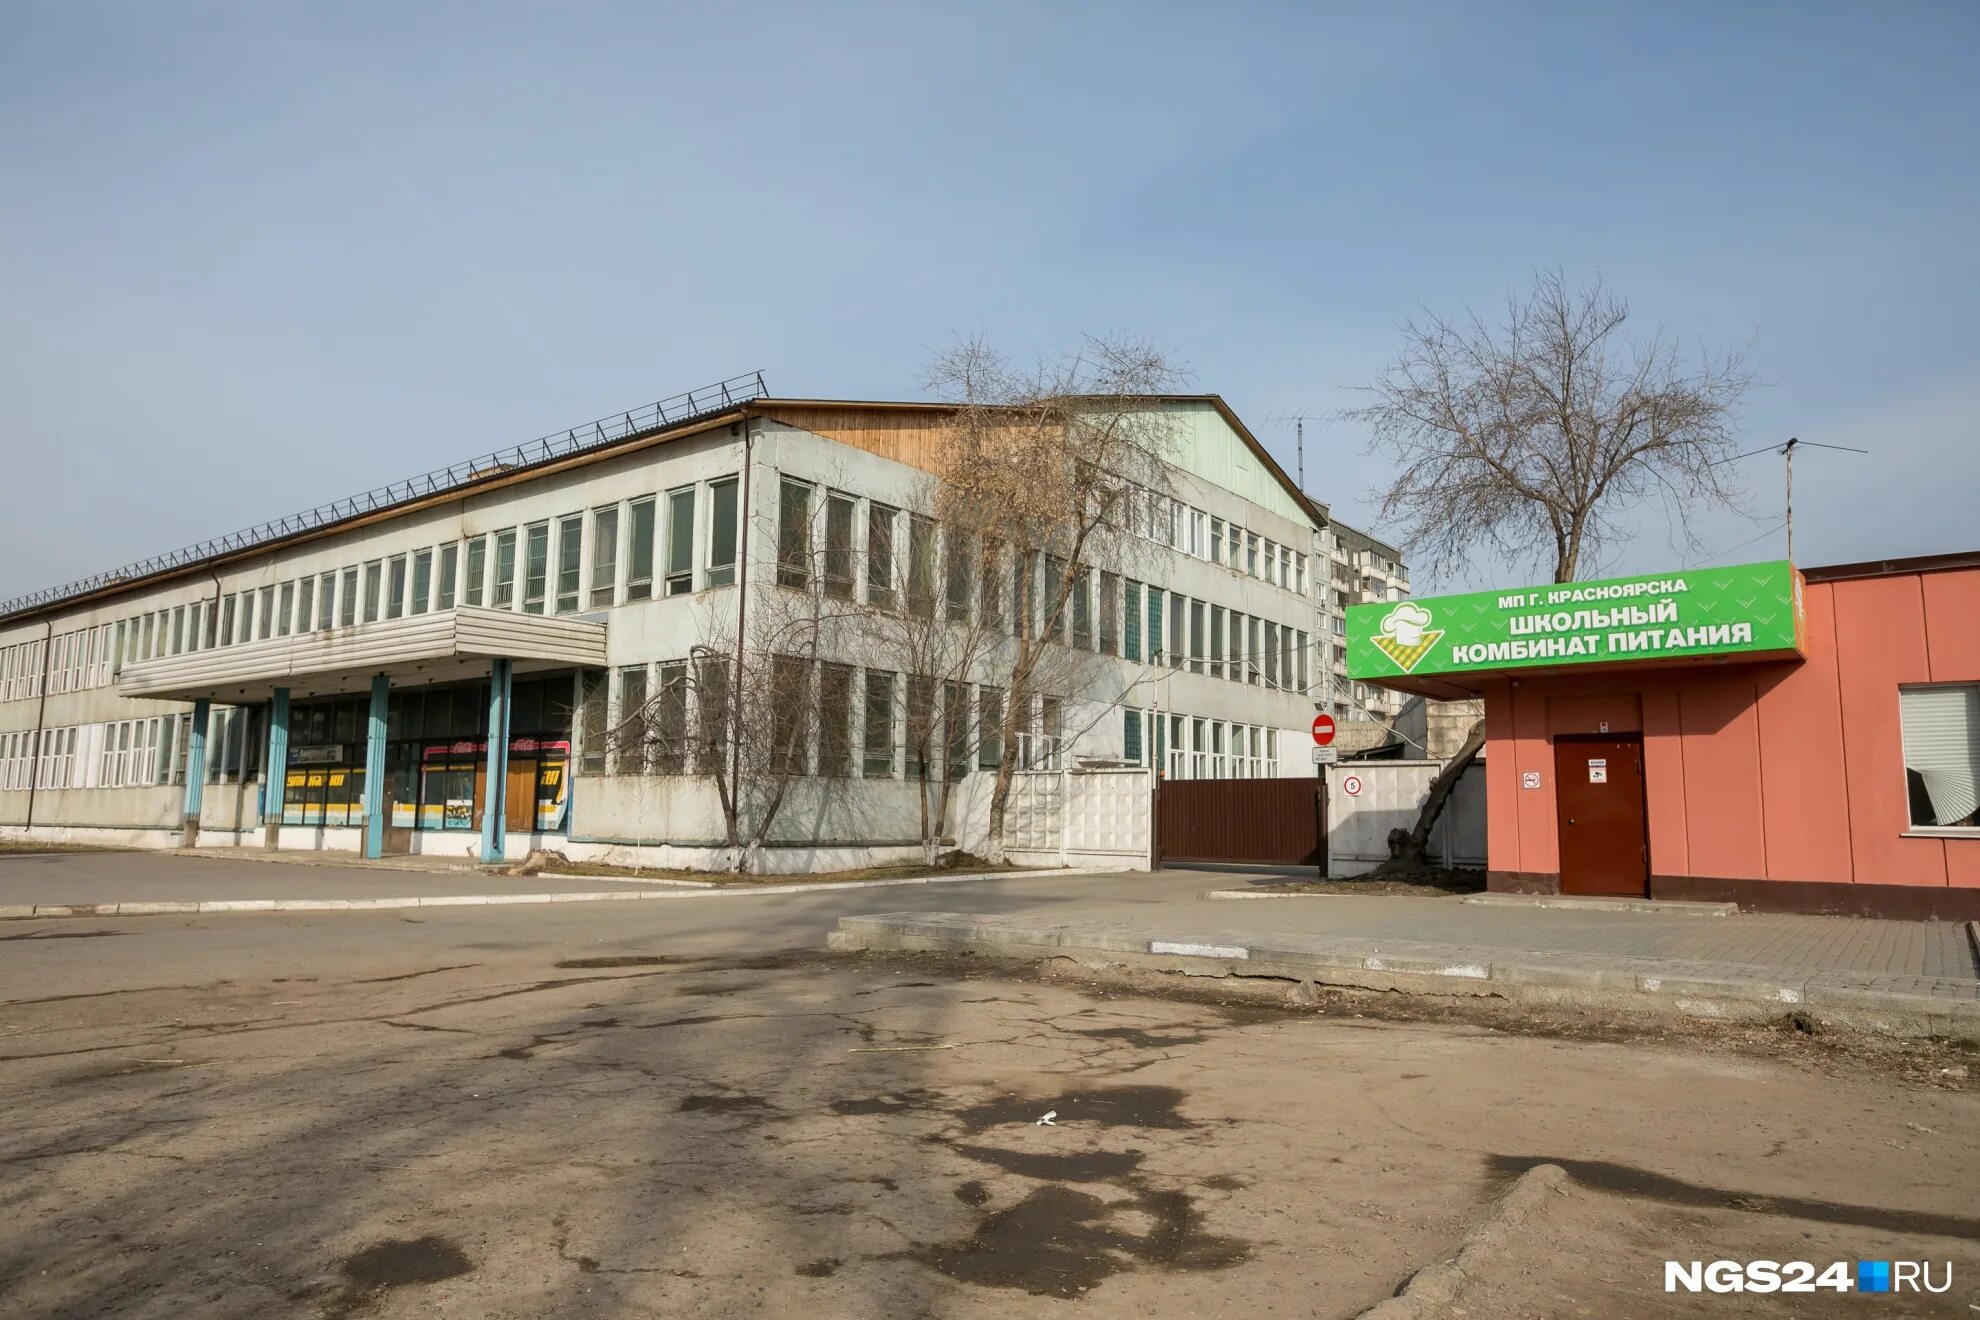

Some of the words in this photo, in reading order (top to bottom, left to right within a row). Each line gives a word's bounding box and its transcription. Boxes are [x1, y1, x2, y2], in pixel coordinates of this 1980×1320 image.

[1498, 595, 1525, 609] МП
[1529, 592, 1544, 607] Г.
[1548, 578, 1688, 605] КРАСНОЯРСКА
[1509, 598, 1678, 636] ШКОЛЬНЫЙ
[1452, 633, 1599, 664] КОМБИНАТ
[1607, 622, 1752, 653] ПИТАНИЯ
[1350, 782, 1356, 790] 5
